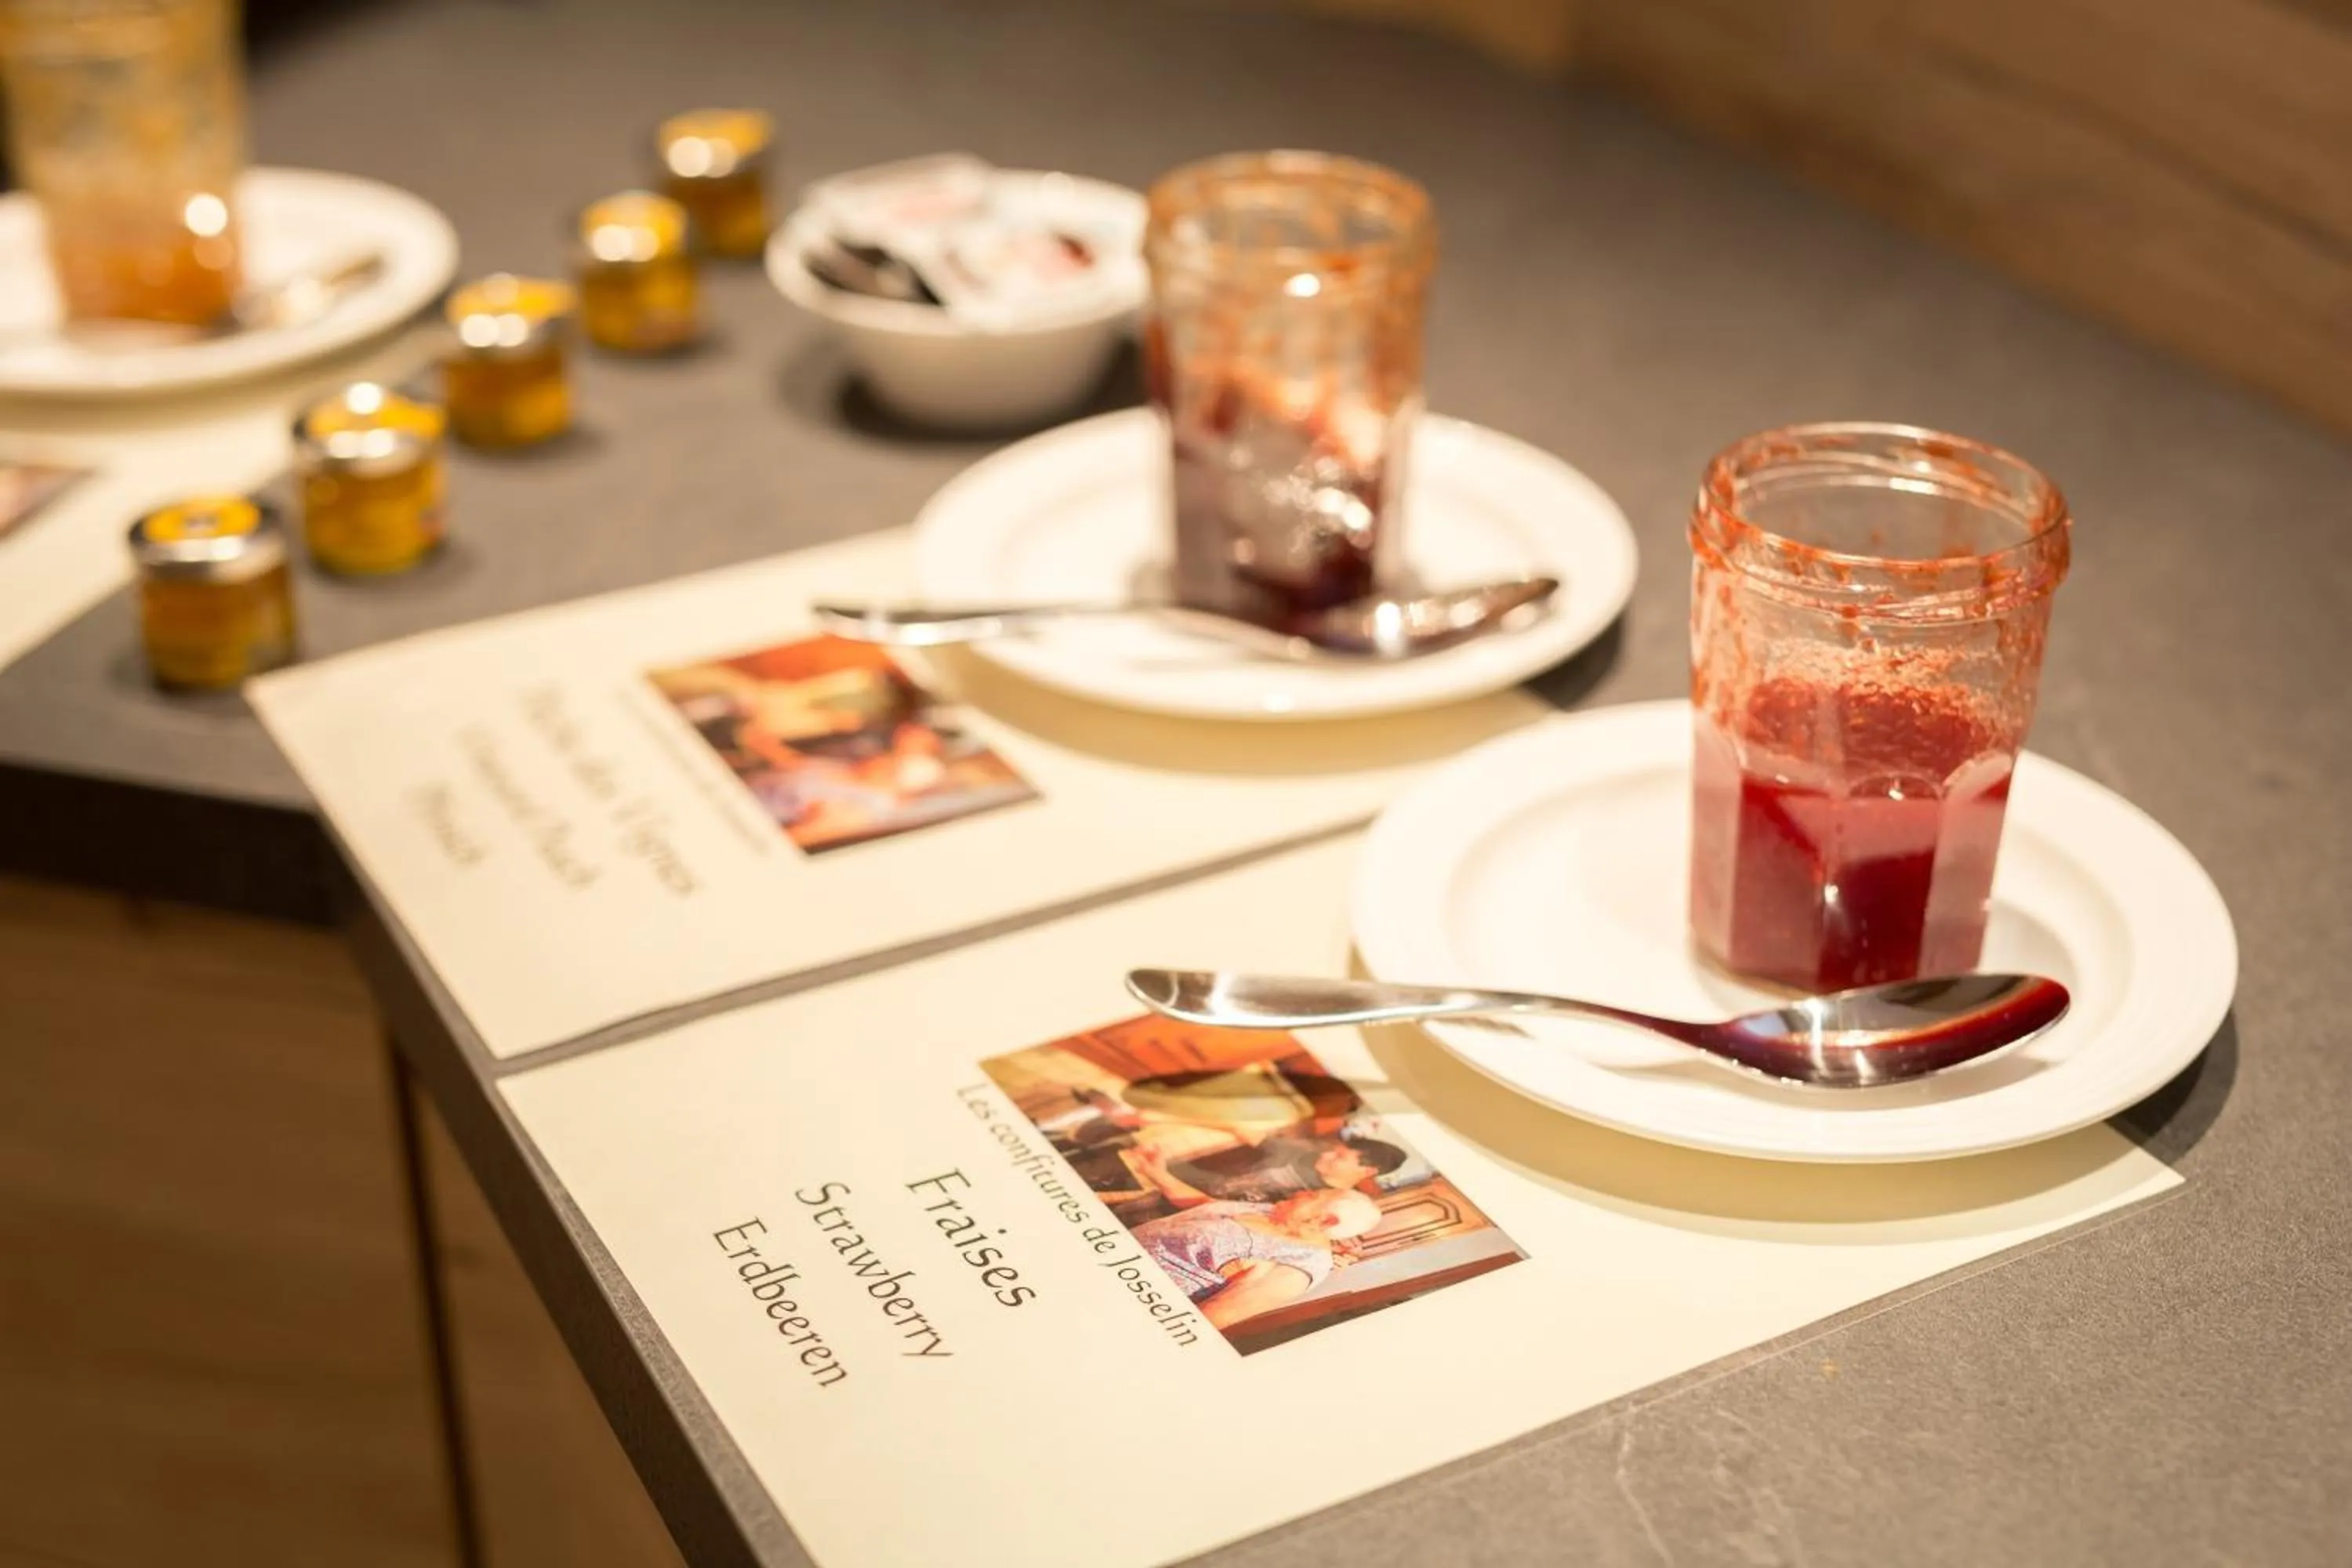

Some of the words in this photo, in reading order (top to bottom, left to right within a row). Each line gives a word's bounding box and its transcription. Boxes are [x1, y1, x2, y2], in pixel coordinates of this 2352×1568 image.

[956, 1083, 991, 1121] Les
[989, 1123, 1091, 1224] confitures
[794, 1181, 955, 1358] Strawberry
[905, 1167, 1036, 1308] Fraises
[1081, 1225, 1116, 1254] de
[712, 1215, 849, 1388] Erdbeeren
[1098, 1254, 1199, 1347] Josselin
